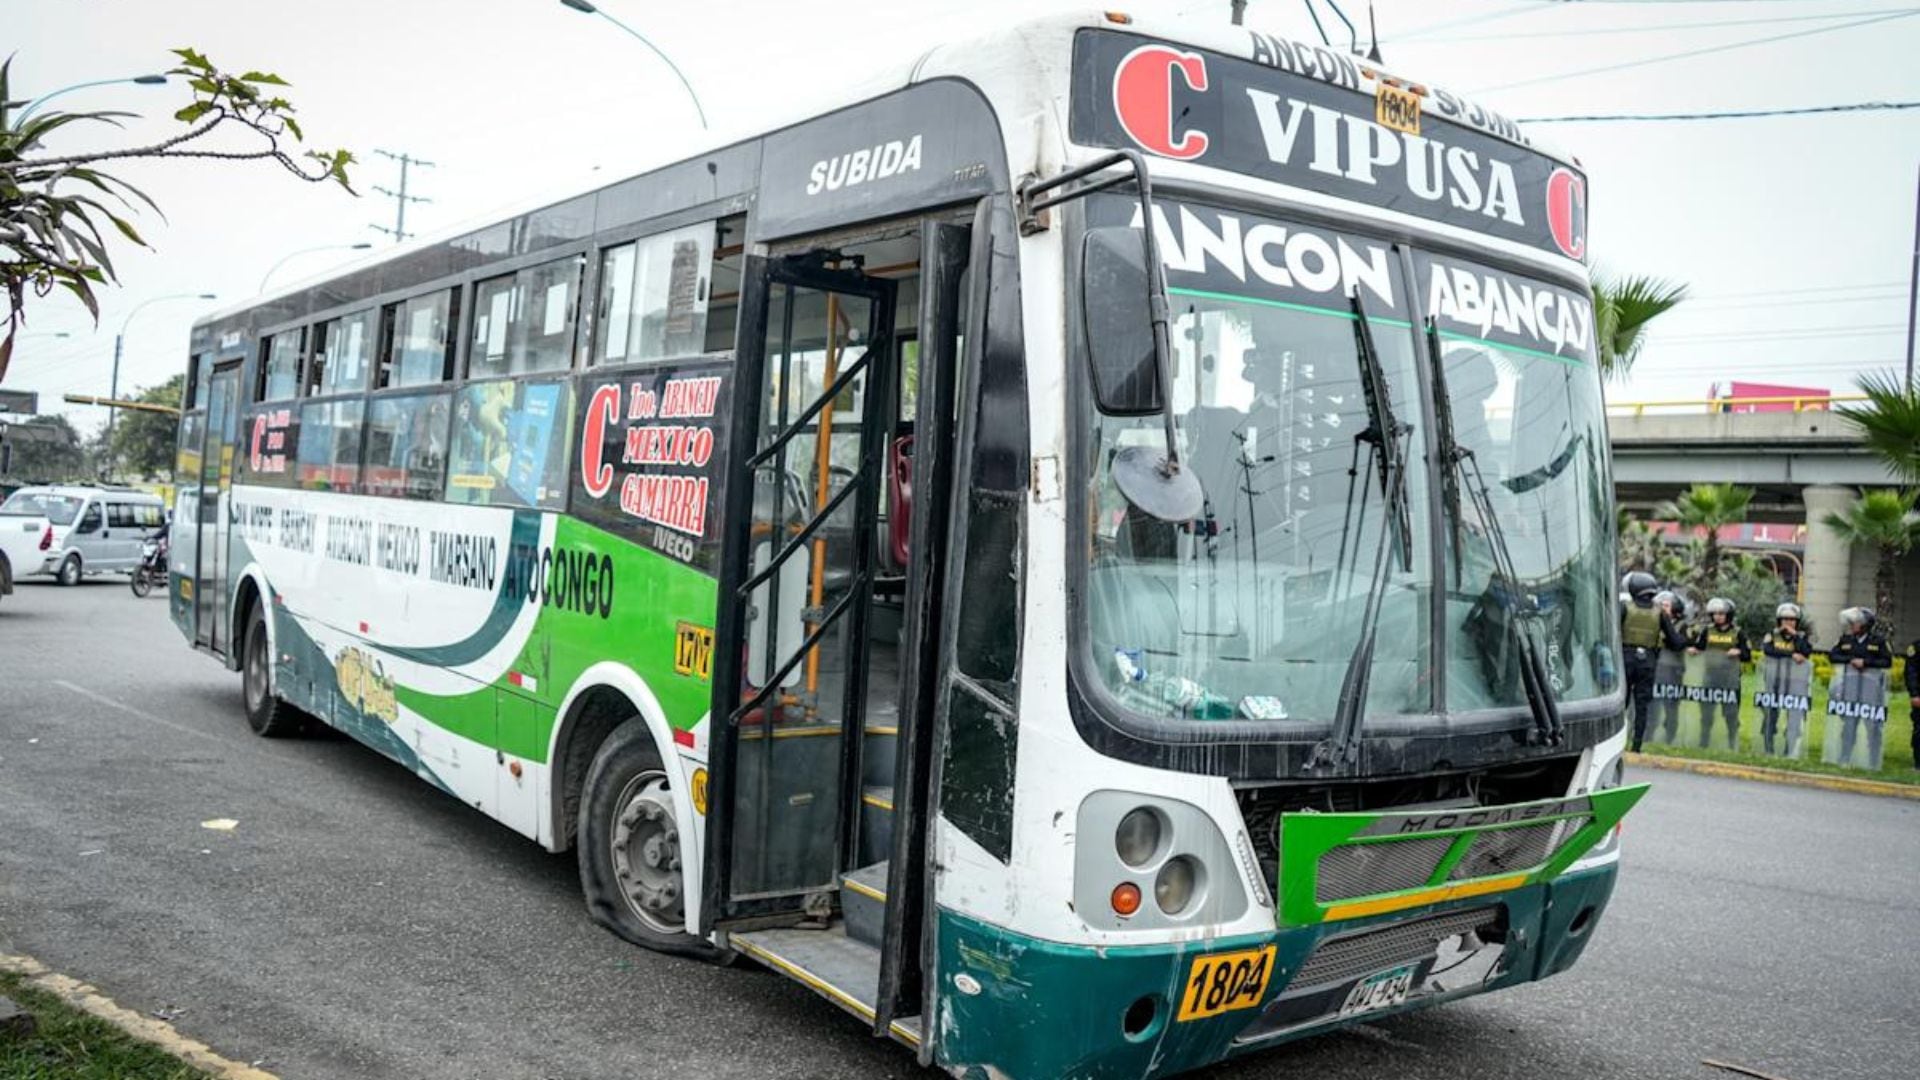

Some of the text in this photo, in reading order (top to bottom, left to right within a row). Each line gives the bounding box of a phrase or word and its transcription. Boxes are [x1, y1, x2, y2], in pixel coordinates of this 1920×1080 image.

[1250, 31, 1359, 91] ANCON
[1380, 89, 1417, 130] 1804
[806, 134, 922, 195] SUBIDA
[1112, 43, 1584, 259] C VIPUSA C
[1130, 201, 1590, 354] ANCON ABANCAY
[659, 376, 722, 418] ABANCAY
[582, 384, 621, 498] C
[622, 426, 714, 467] MEXICO
[620, 473, 709, 537] GAMARRA
[376, 521, 420, 575] MEXICO
[430, 530, 496, 591] T.MARSANO
[505, 543, 614, 619] ATOCONGO
[653, 526, 694, 562] IVECO
[1686, 686, 1737, 703] POLICIA
[1755, 692, 1808, 710] POLICIA
[1828, 700, 1885, 720] POLICIA
[1190, 954, 1268, 1013] 1804
